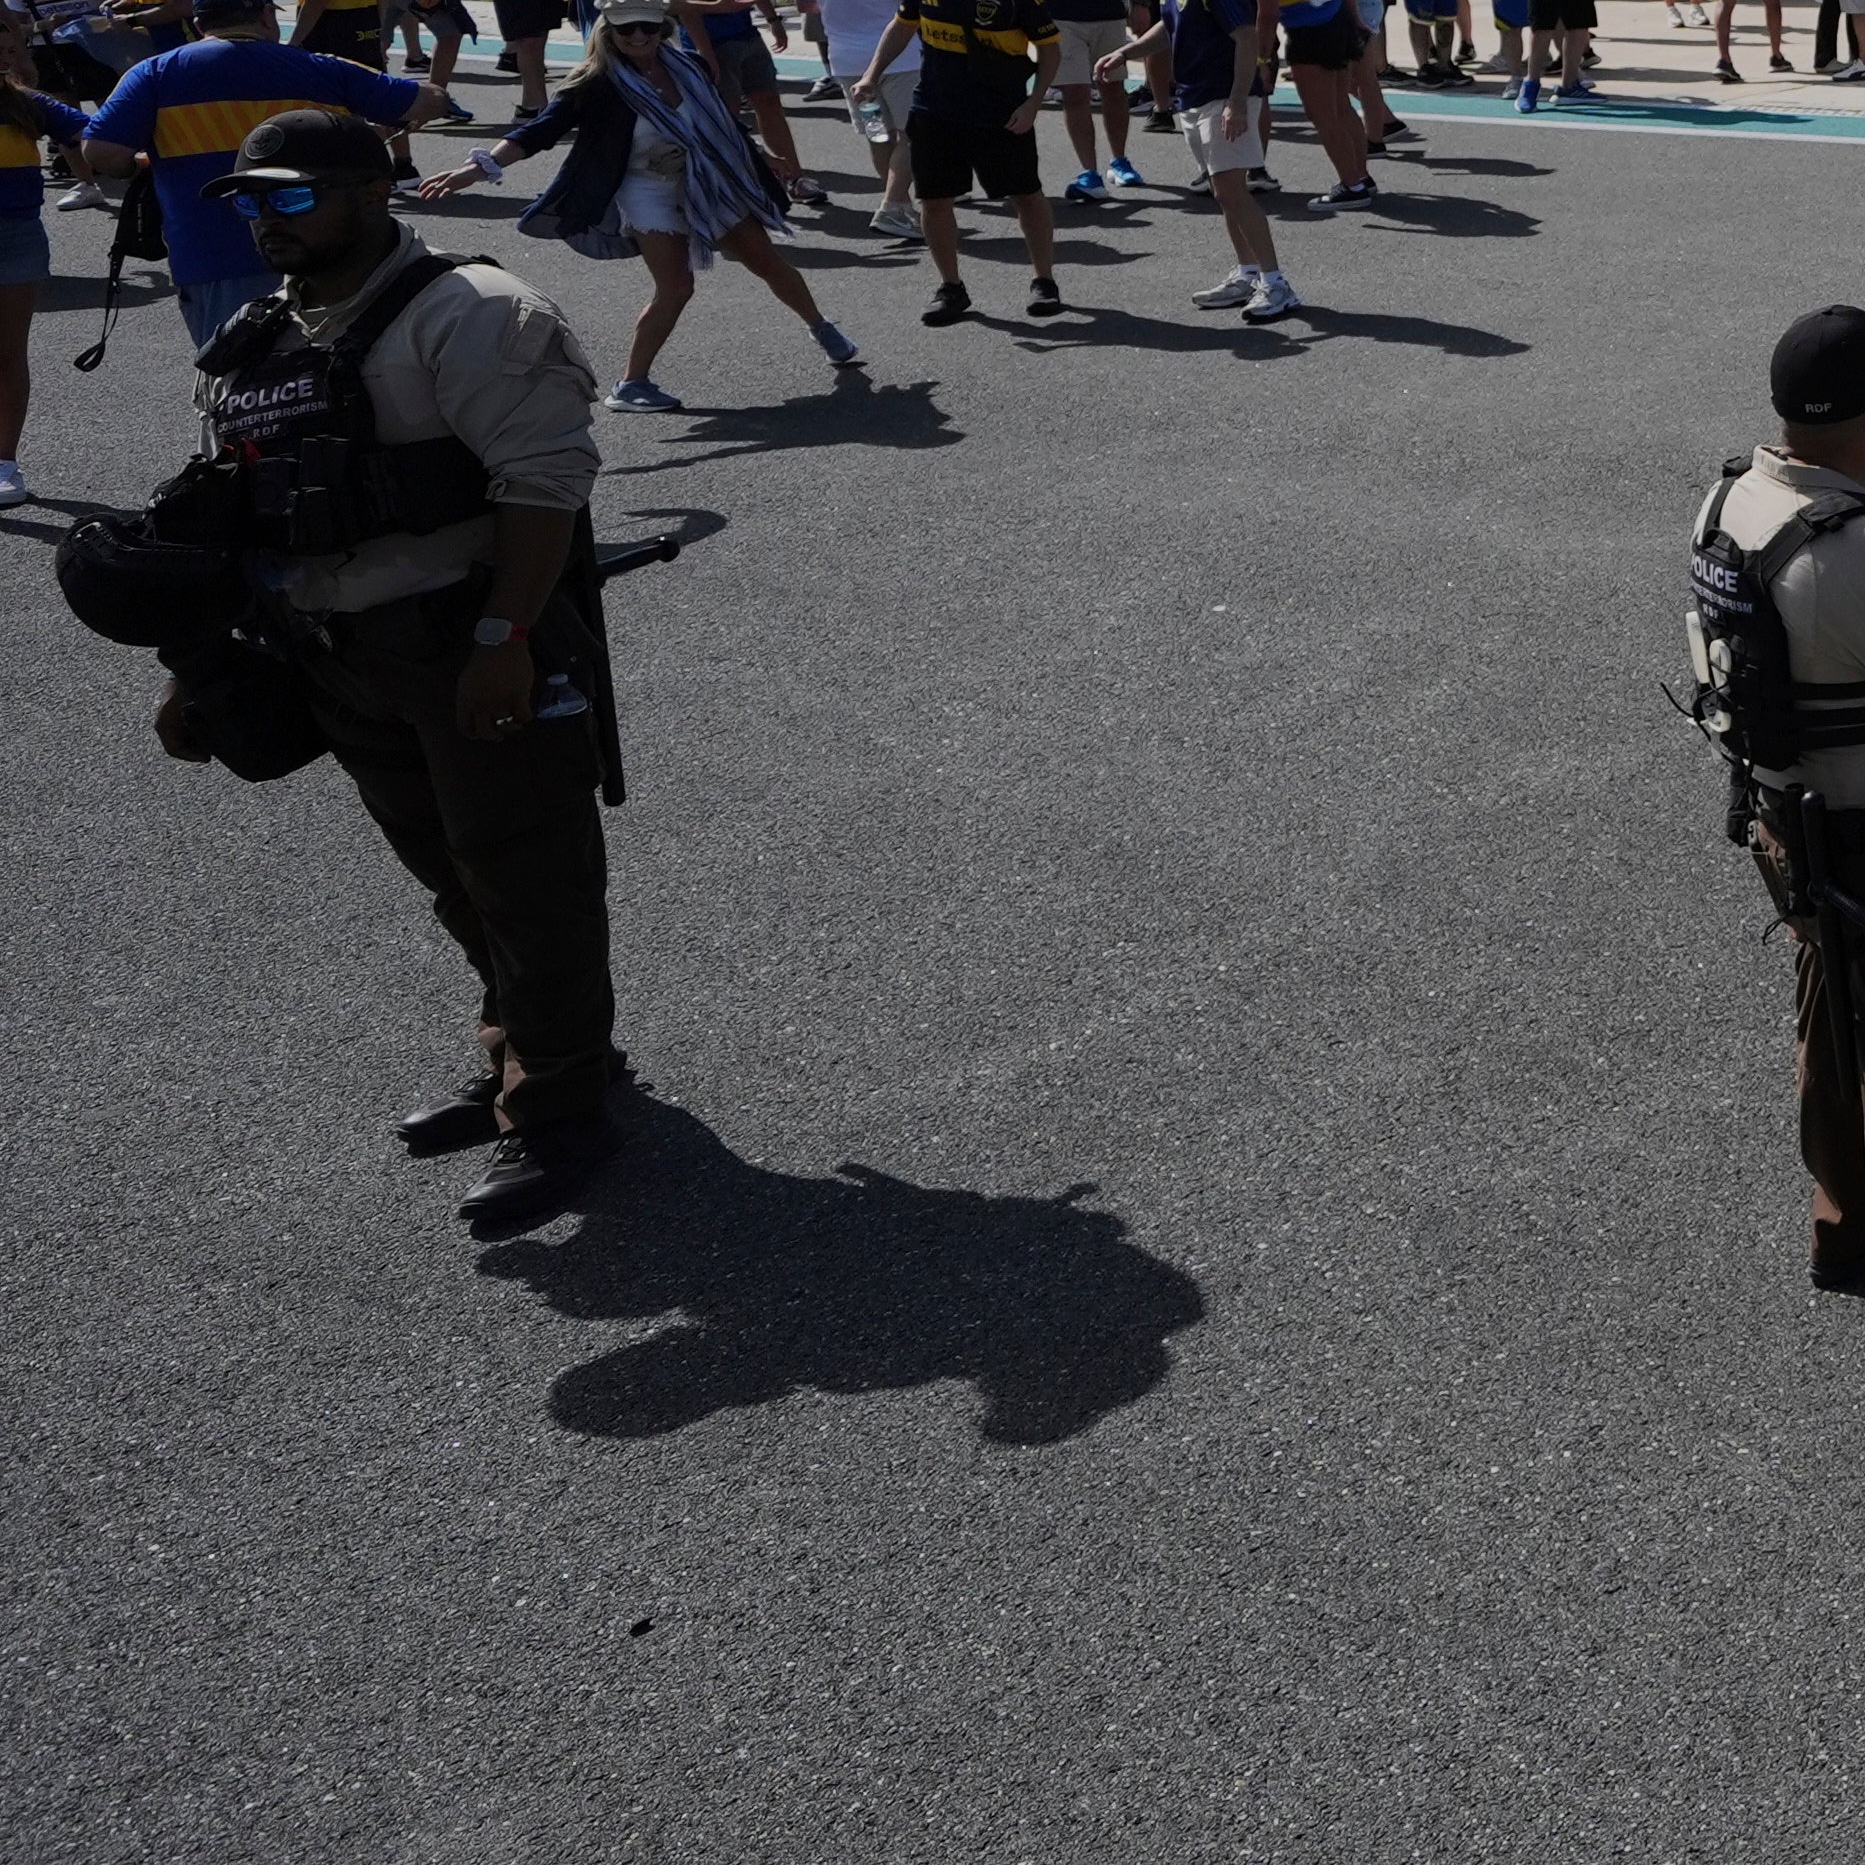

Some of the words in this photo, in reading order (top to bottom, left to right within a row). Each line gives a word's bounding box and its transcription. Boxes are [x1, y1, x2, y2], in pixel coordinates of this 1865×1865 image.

[227, 377, 316, 415] POLICE
[1804, 402, 1833, 414] RDF
[217, 400, 329, 434] COUNTERTERRORISM
